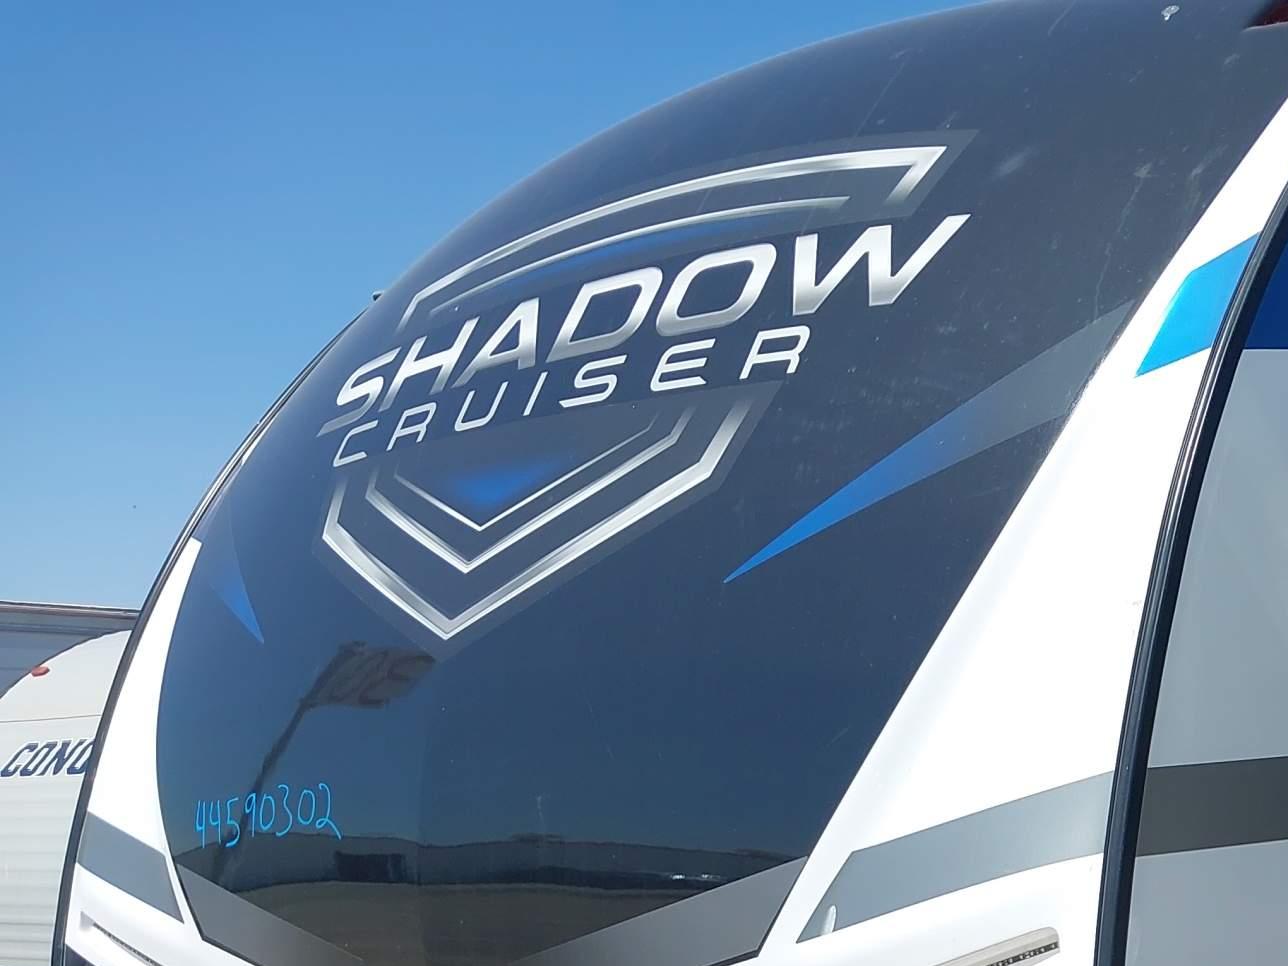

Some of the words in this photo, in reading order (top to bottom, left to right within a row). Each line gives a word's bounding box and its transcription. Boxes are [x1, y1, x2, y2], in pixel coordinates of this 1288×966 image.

[316, 213, 971, 438] SHADOW
[332, 325, 811, 468] CRUISER
[194, 782, 343, 849] 44590302
